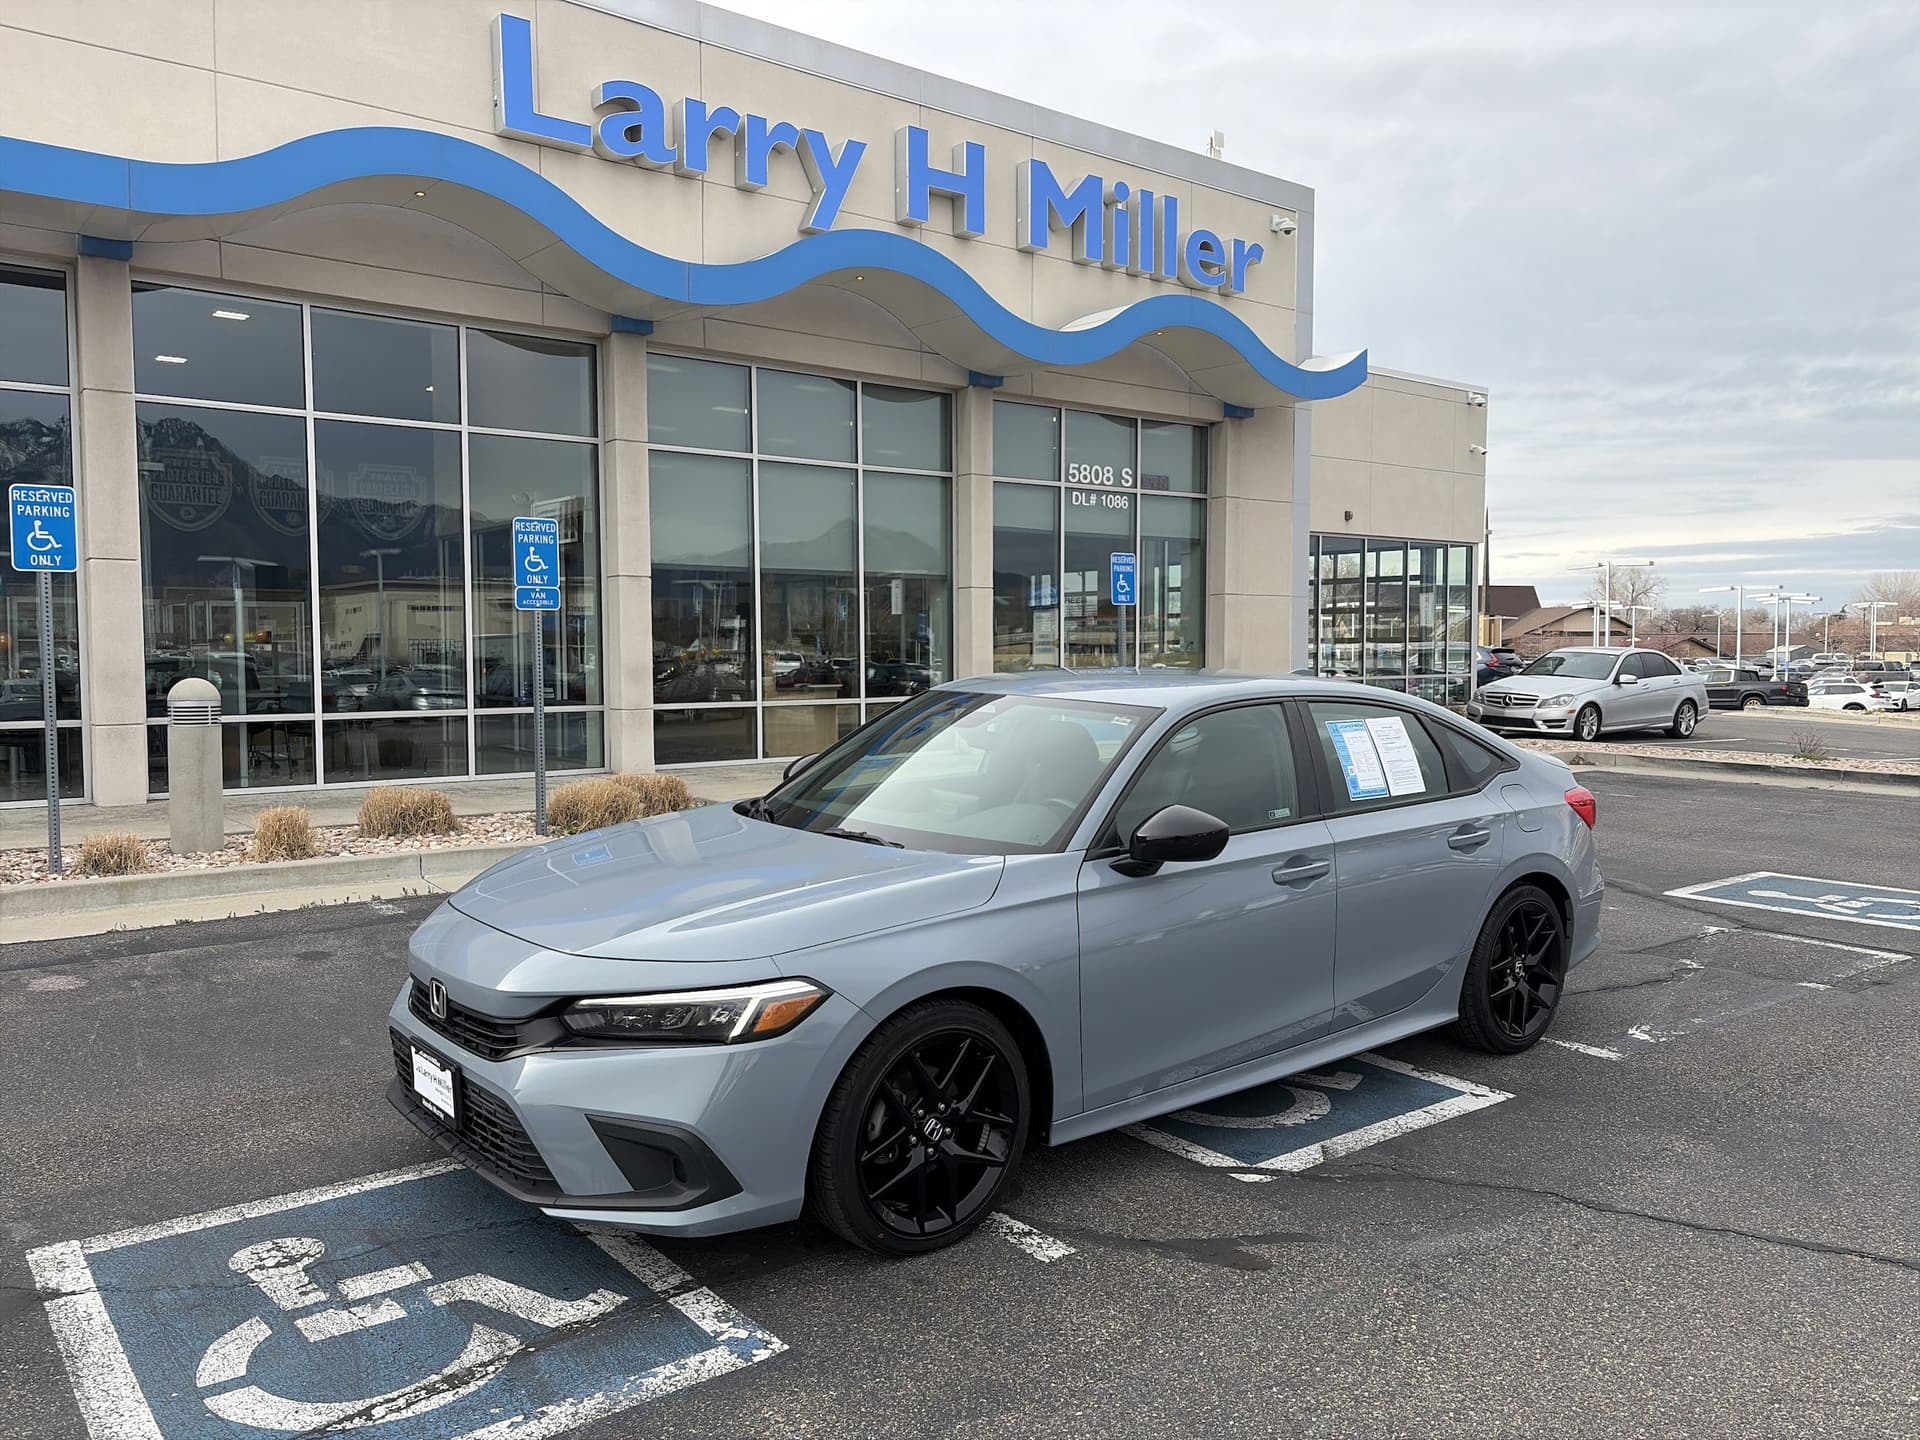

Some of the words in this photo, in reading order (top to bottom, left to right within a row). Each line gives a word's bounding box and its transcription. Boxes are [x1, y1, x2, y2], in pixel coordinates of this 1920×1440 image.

[491, 12, 868, 233] Larry
[895, 124, 986, 237] H
[1017, 157, 1265, 295] Miller
[1068, 463, 1114, 486] 5808
[1121, 467, 1133, 487] S
[12, 489, 73, 504] RESERVED
[1072, 491, 1097, 506] DL#
[1101, 494, 1129, 509] 1086
[17, 504, 70, 518] PARKING
[515, 521, 556, 533] RESERVED
[518, 533, 554, 544] PARKING
[30, 554, 62, 566] ONLY
[526, 574, 549, 584] ONLY
[530, 591, 546, 599] VAN
